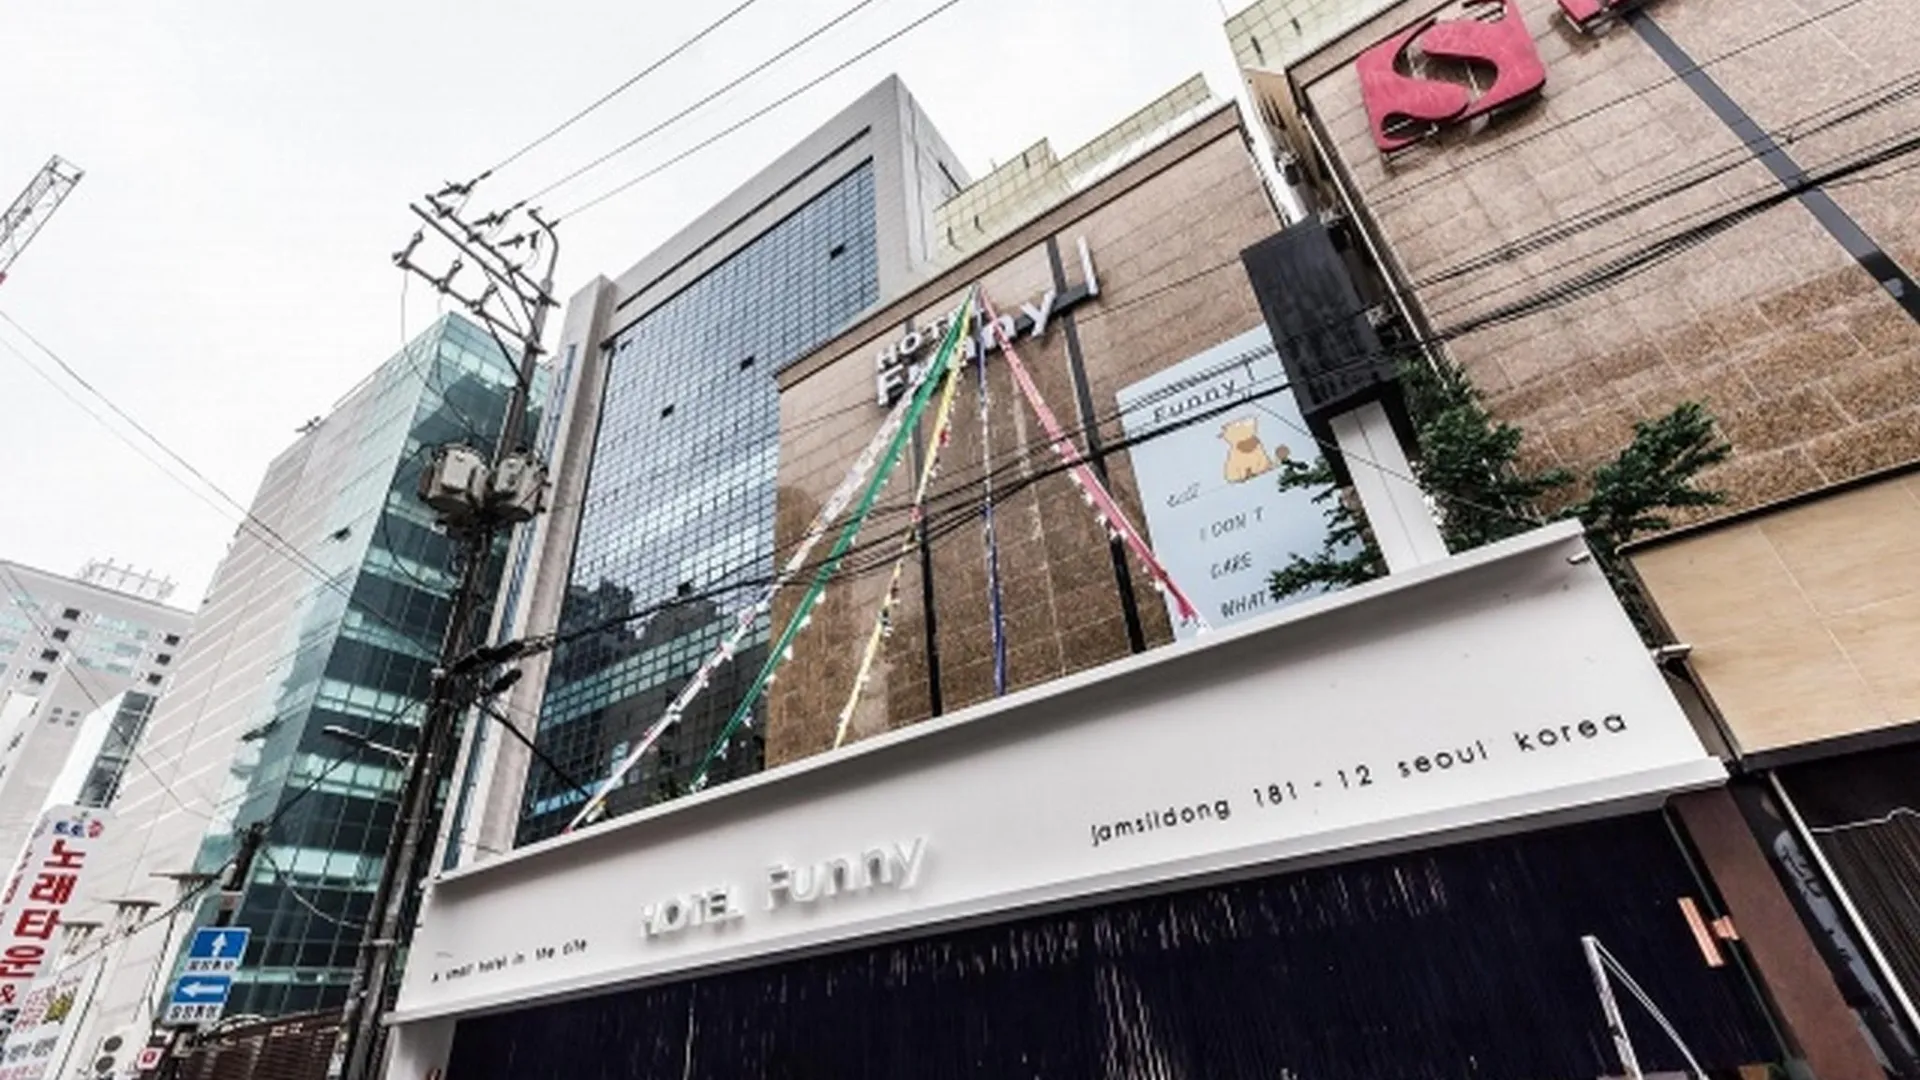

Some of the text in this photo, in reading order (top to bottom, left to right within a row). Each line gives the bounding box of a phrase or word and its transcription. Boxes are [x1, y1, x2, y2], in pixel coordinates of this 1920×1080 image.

[1091, 799, 1231, 847] jamsildong
[1253, 782, 1298, 807] 181
[1398, 739, 1489, 778] seoul
[1513, 714, 1628, 752] korea
[640, 835, 929, 936] HOTEL Funny
